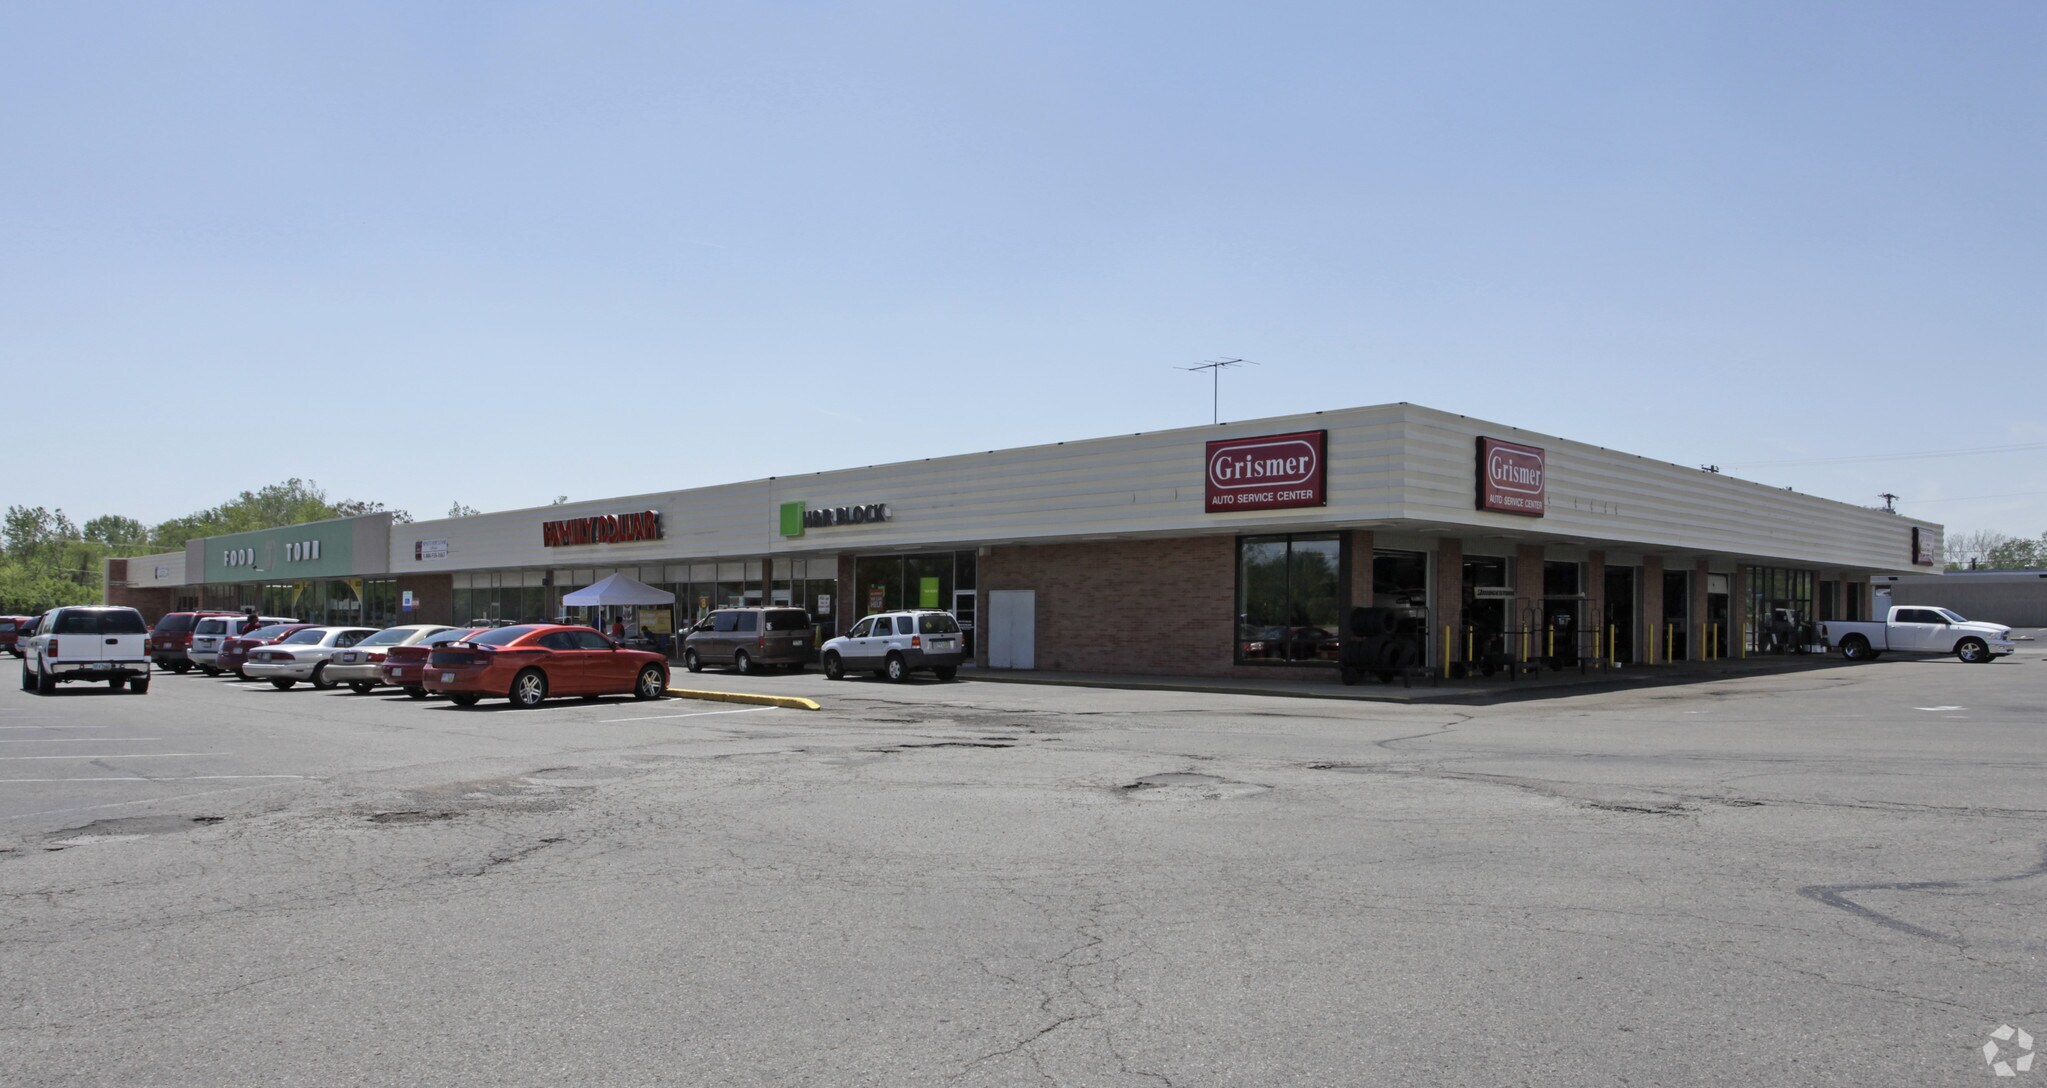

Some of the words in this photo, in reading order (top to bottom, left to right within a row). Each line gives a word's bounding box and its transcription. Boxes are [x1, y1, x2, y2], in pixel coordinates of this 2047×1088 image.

[1215, 454, 1309, 480] Grismer
[1491, 455, 1541, 486] Grismer
[1212, 495, 1234, 505] AUTO
[1237, 492, 1274, 504] SERVICE
[1277, 489, 1313, 501] CENTER
[1489, 494, 1504, 505] AUTO
[1503, 496, 1524, 507] SERVICE
[1525, 499, 1543, 509] CENTER
[836, 503, 888, 525] BLOCK
[543, 517, 594, 547] FAMILY
[597, 510, 660, 544] DOLLAR
[224, 548, 255, 567] FOOD
[286, 540, 320, 562] TOWN
